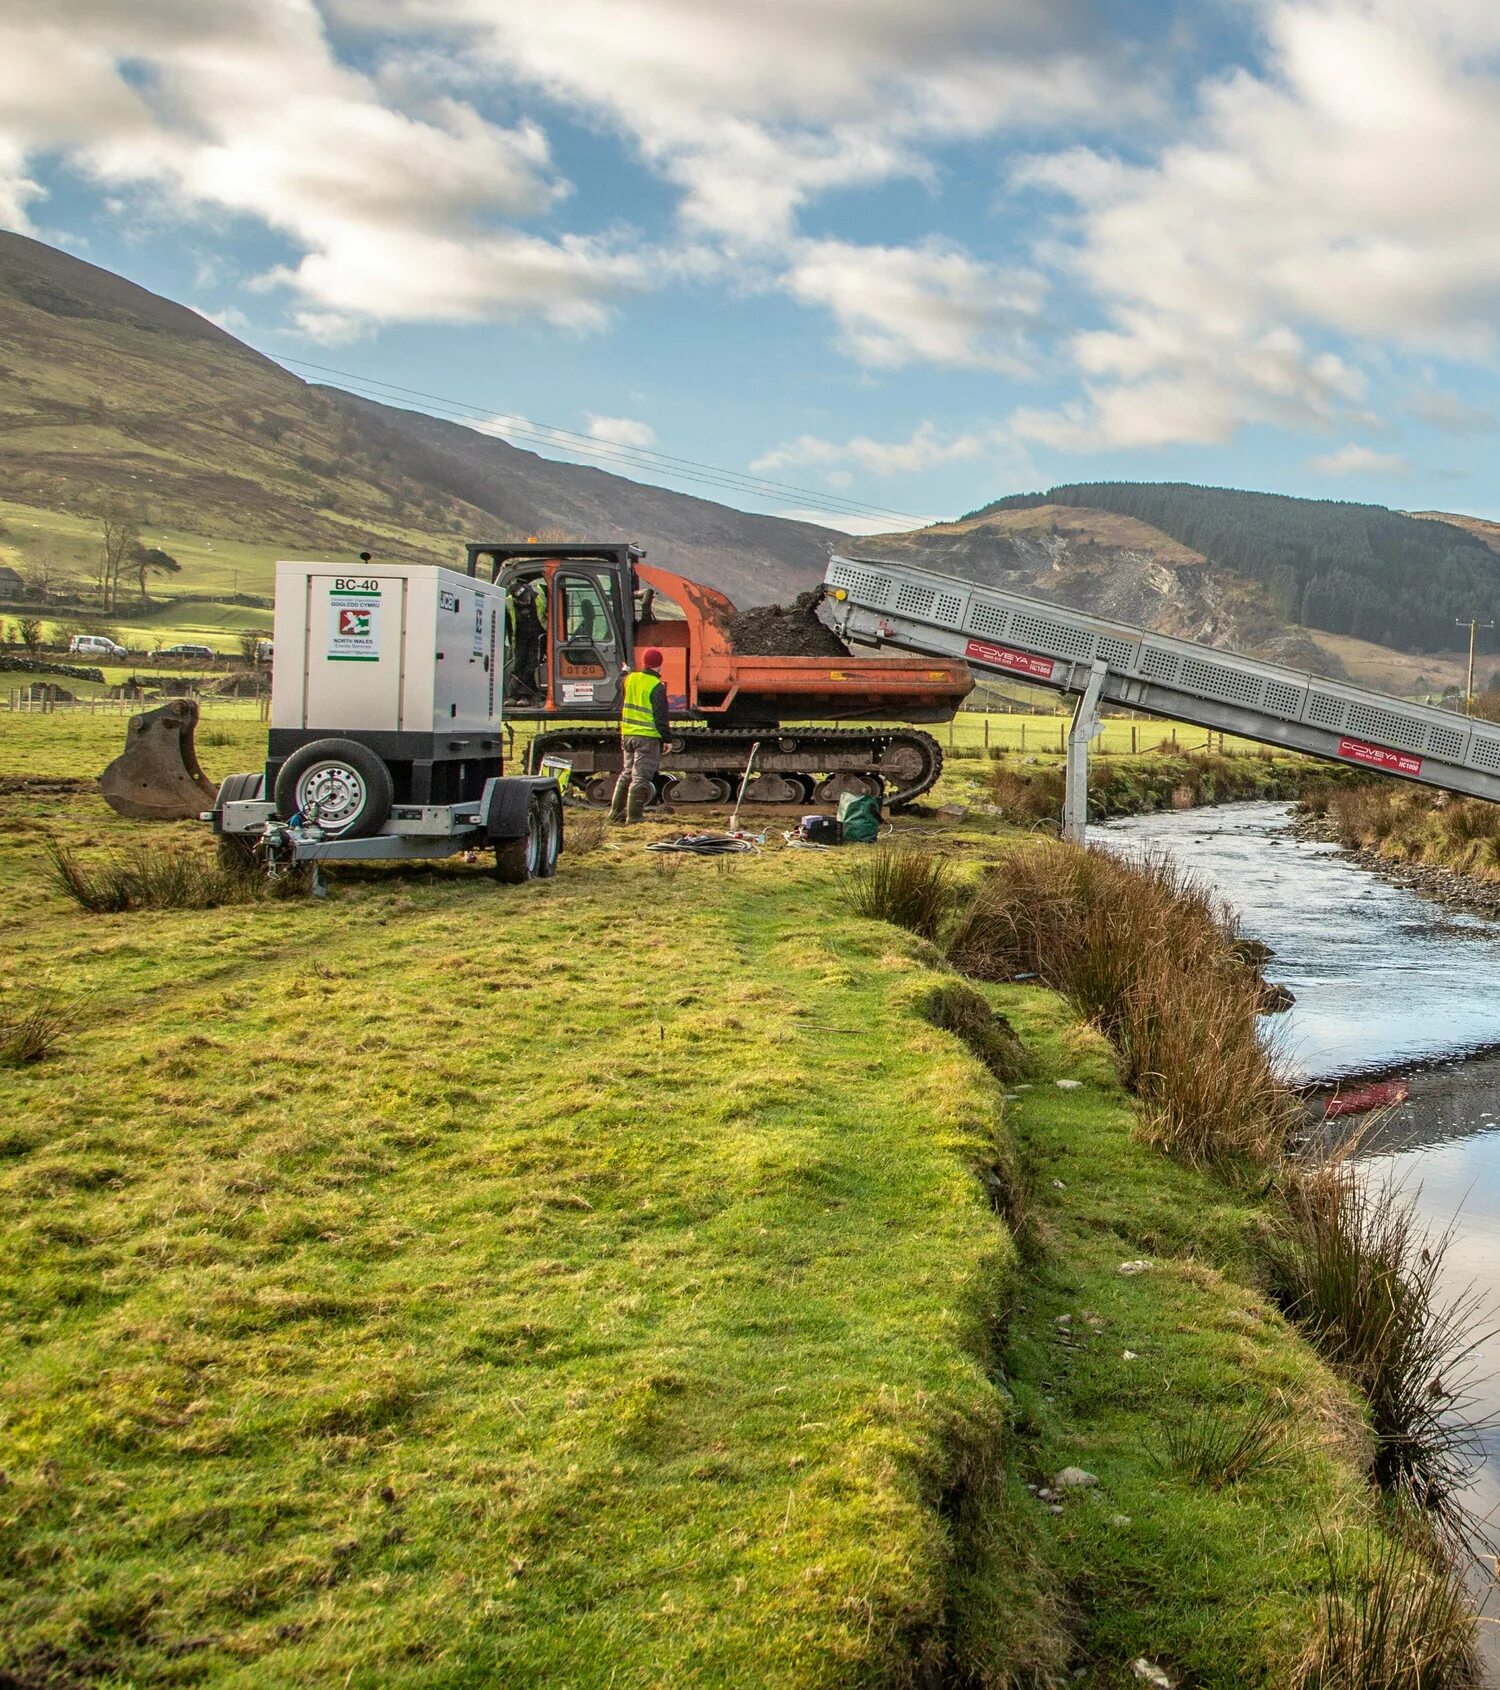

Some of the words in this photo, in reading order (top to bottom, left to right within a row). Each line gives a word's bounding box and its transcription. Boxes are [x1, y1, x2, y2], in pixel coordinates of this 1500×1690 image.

[335, 579, 379, 591] BC-40
[440, 592, 454, 611] JCB
[969, 643, 1028, 665] COVEYA
[567, 666, 596, 675] DT20
[1341, 741, 1398, 762] COVEYA
[1398, 761, 1419, 772] HC1000
